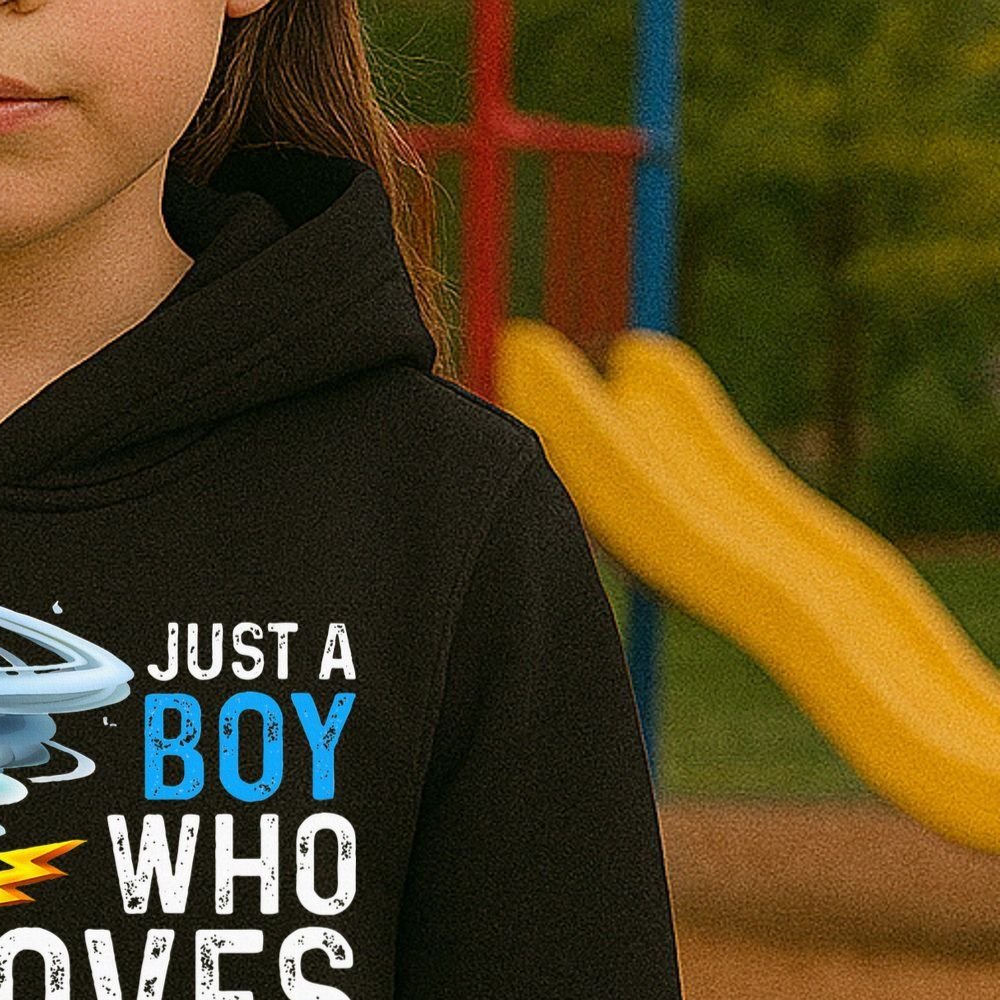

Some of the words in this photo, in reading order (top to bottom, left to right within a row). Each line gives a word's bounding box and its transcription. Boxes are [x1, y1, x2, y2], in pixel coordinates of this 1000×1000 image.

[147, 622, 299, 681] JUST
[319, 623, 357, 680] A
[144, 691, 356, 802] BOY
[107, 813, 357, 915] WHO
